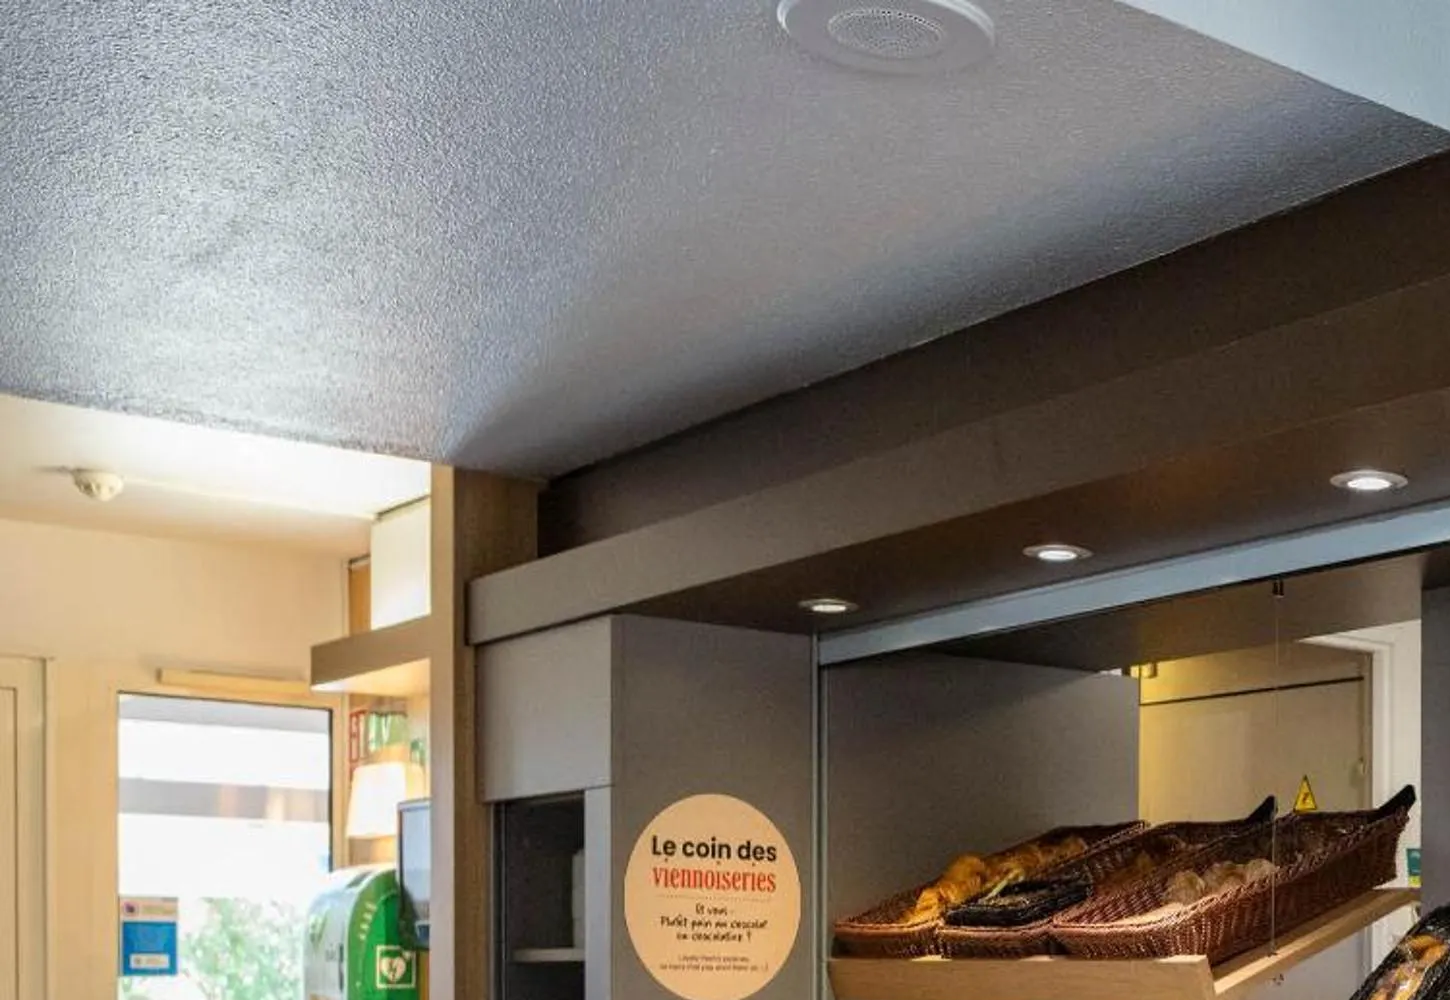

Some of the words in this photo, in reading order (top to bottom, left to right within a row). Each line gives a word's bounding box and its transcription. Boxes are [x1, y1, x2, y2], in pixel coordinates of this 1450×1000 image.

[652, 835, 676, 857] Le
[682, 836, 731, 860] coin
[738, 840, 778, 862] des
[652, 858, 777, 894] viennoiseries
